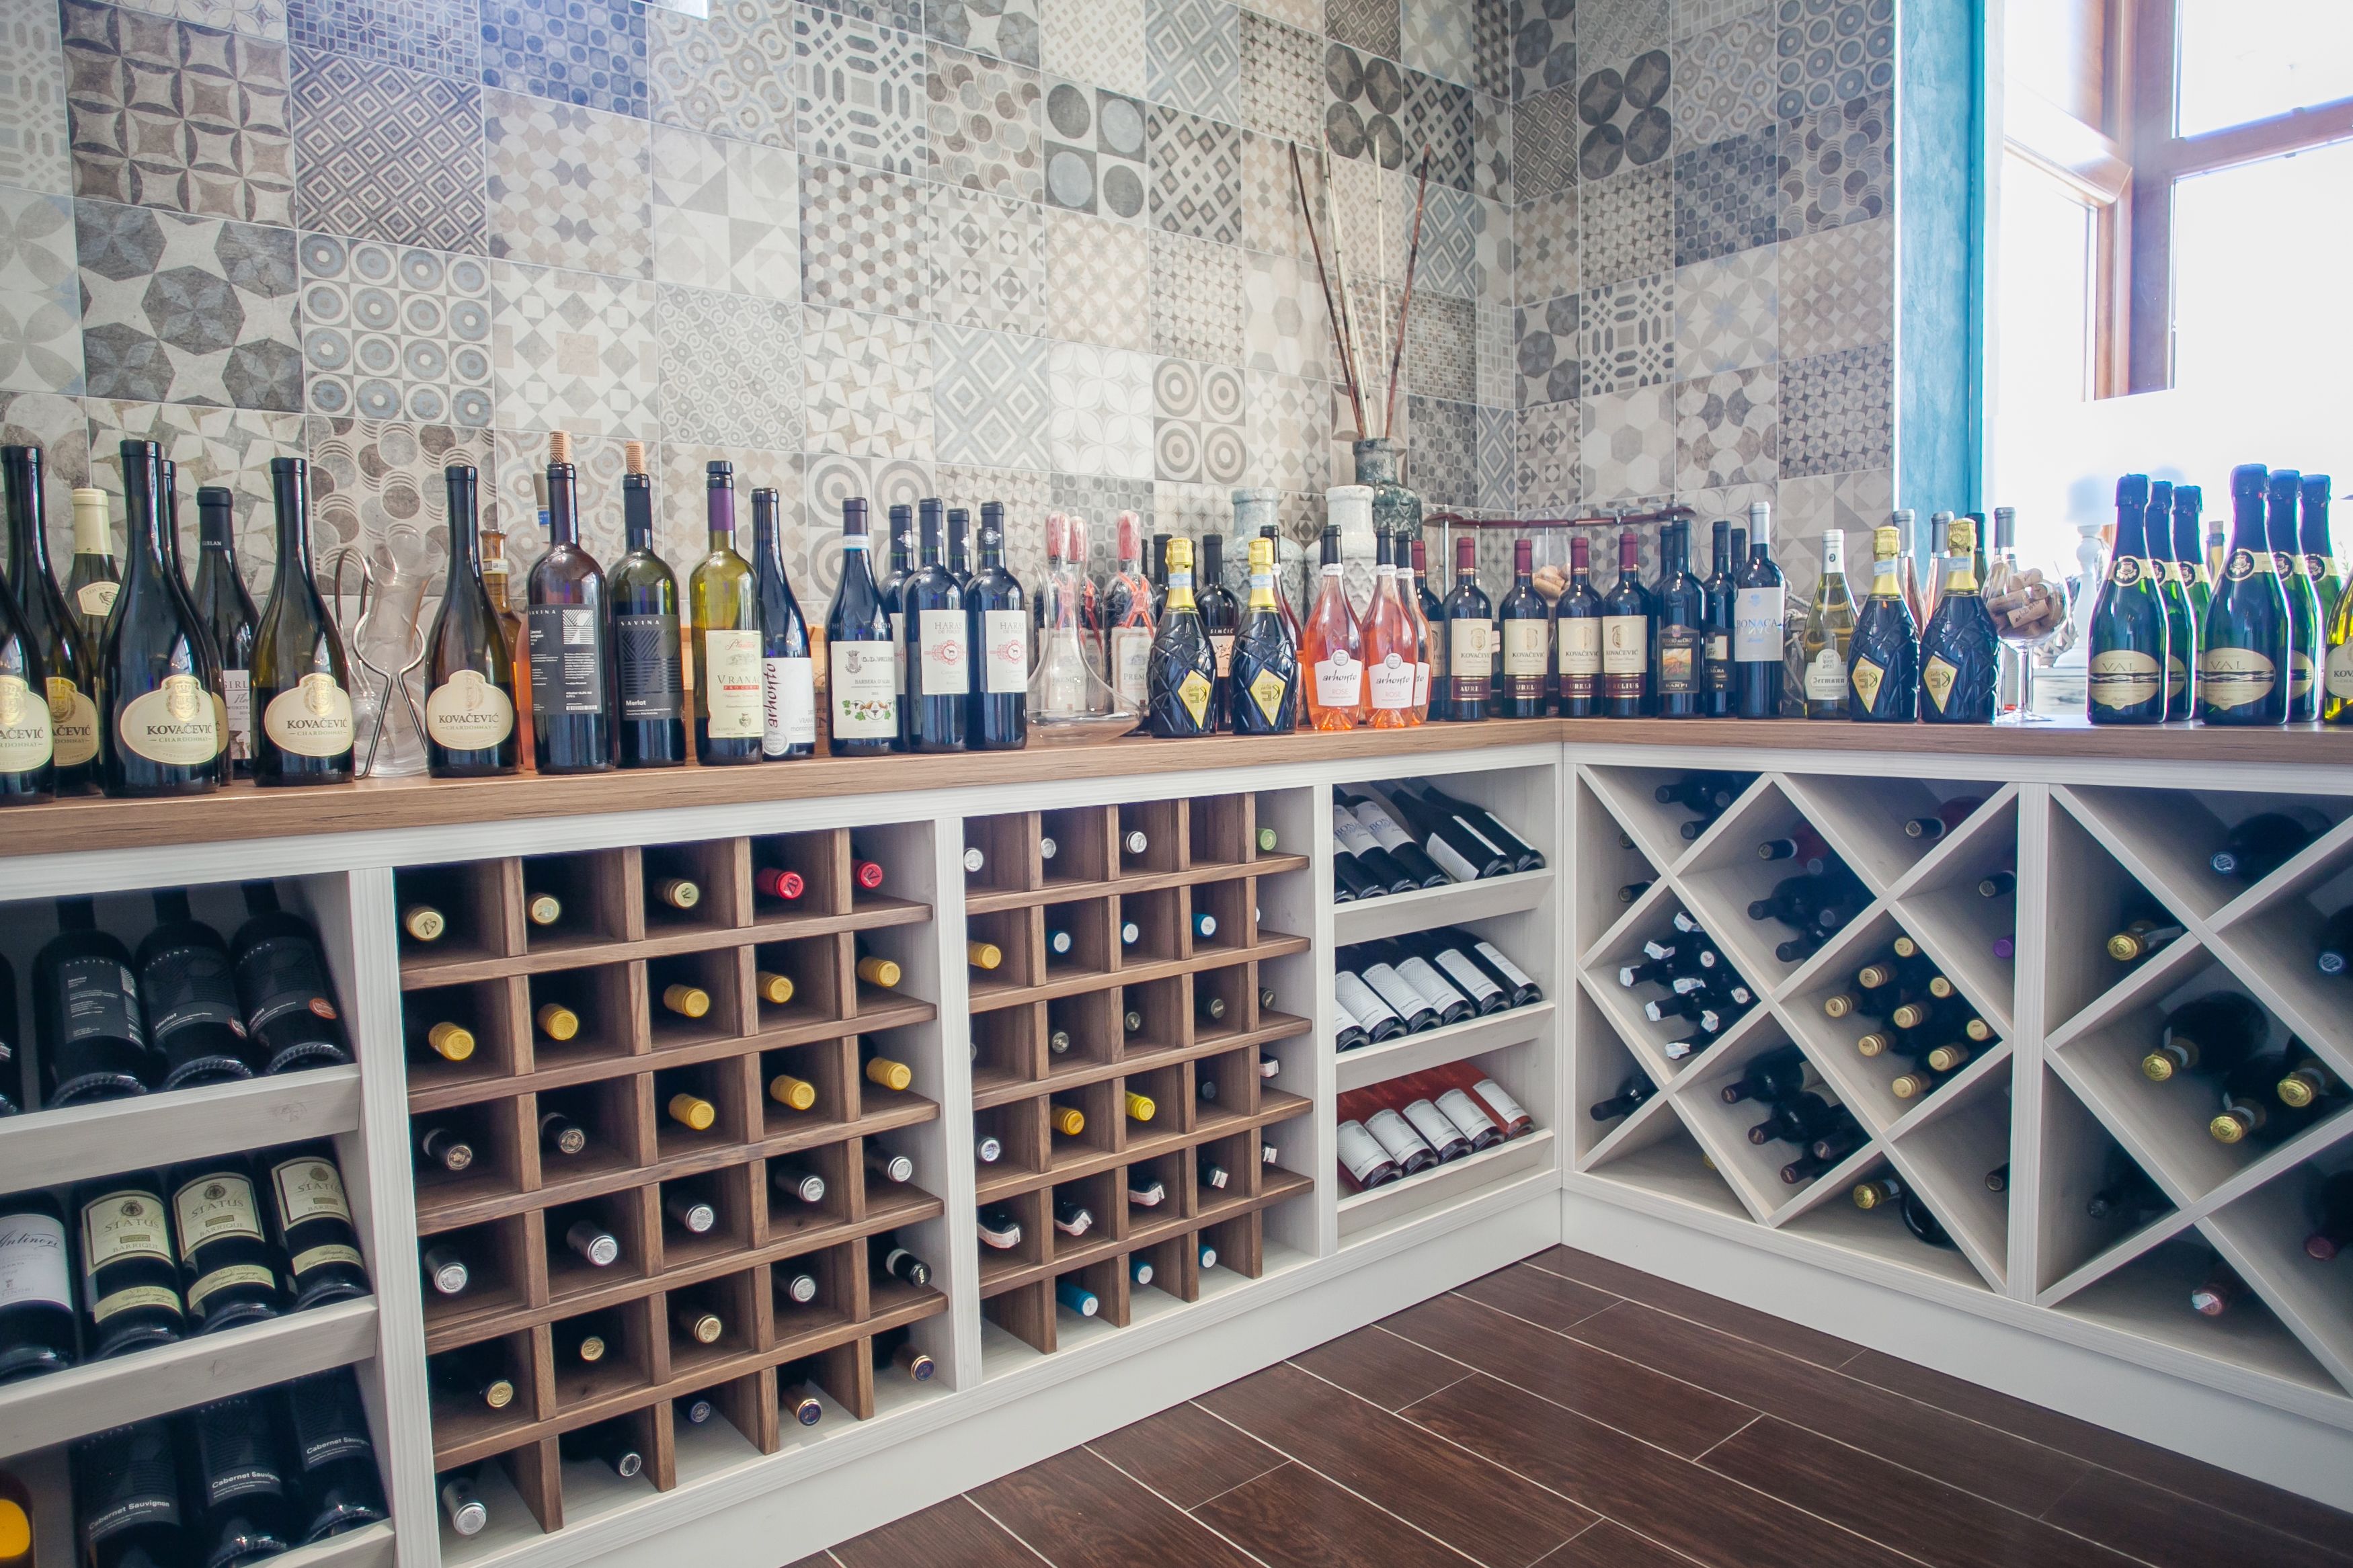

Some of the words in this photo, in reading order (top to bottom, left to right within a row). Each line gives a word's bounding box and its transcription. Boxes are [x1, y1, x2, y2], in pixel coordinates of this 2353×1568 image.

[934, 622, 962, 630] HARAS
[1000, 622, 1025, 630] HARAS
[2102, 663, 2138, 671] VAL
[2210, 661, 2245, 669] VAL
[1322, 669, 1357, 685] arhonto
[1375, 673, 1410, 686] arhonto
[763, 663, 782, 728] arhonto
[287, 718, 348, 729] KOVAČEVIĆ
[438, 713, 499, 723] KOVAČEVIĆ
[147, 723, 212, 735] KOVAČEVIĆ
[155, 1013, 177, 1031] Merlot
[191, 1199, 244, 1219] STATUS
[104, 1218, 160, 1232] STATUS
[307, 1438, 342, 1454] Cabernet
[212, 1473, 250, 1489] Cabernet
[89, 1507, 126, 1530] Cabernet
[128, 1500, 170, 1510] Sauvignon
